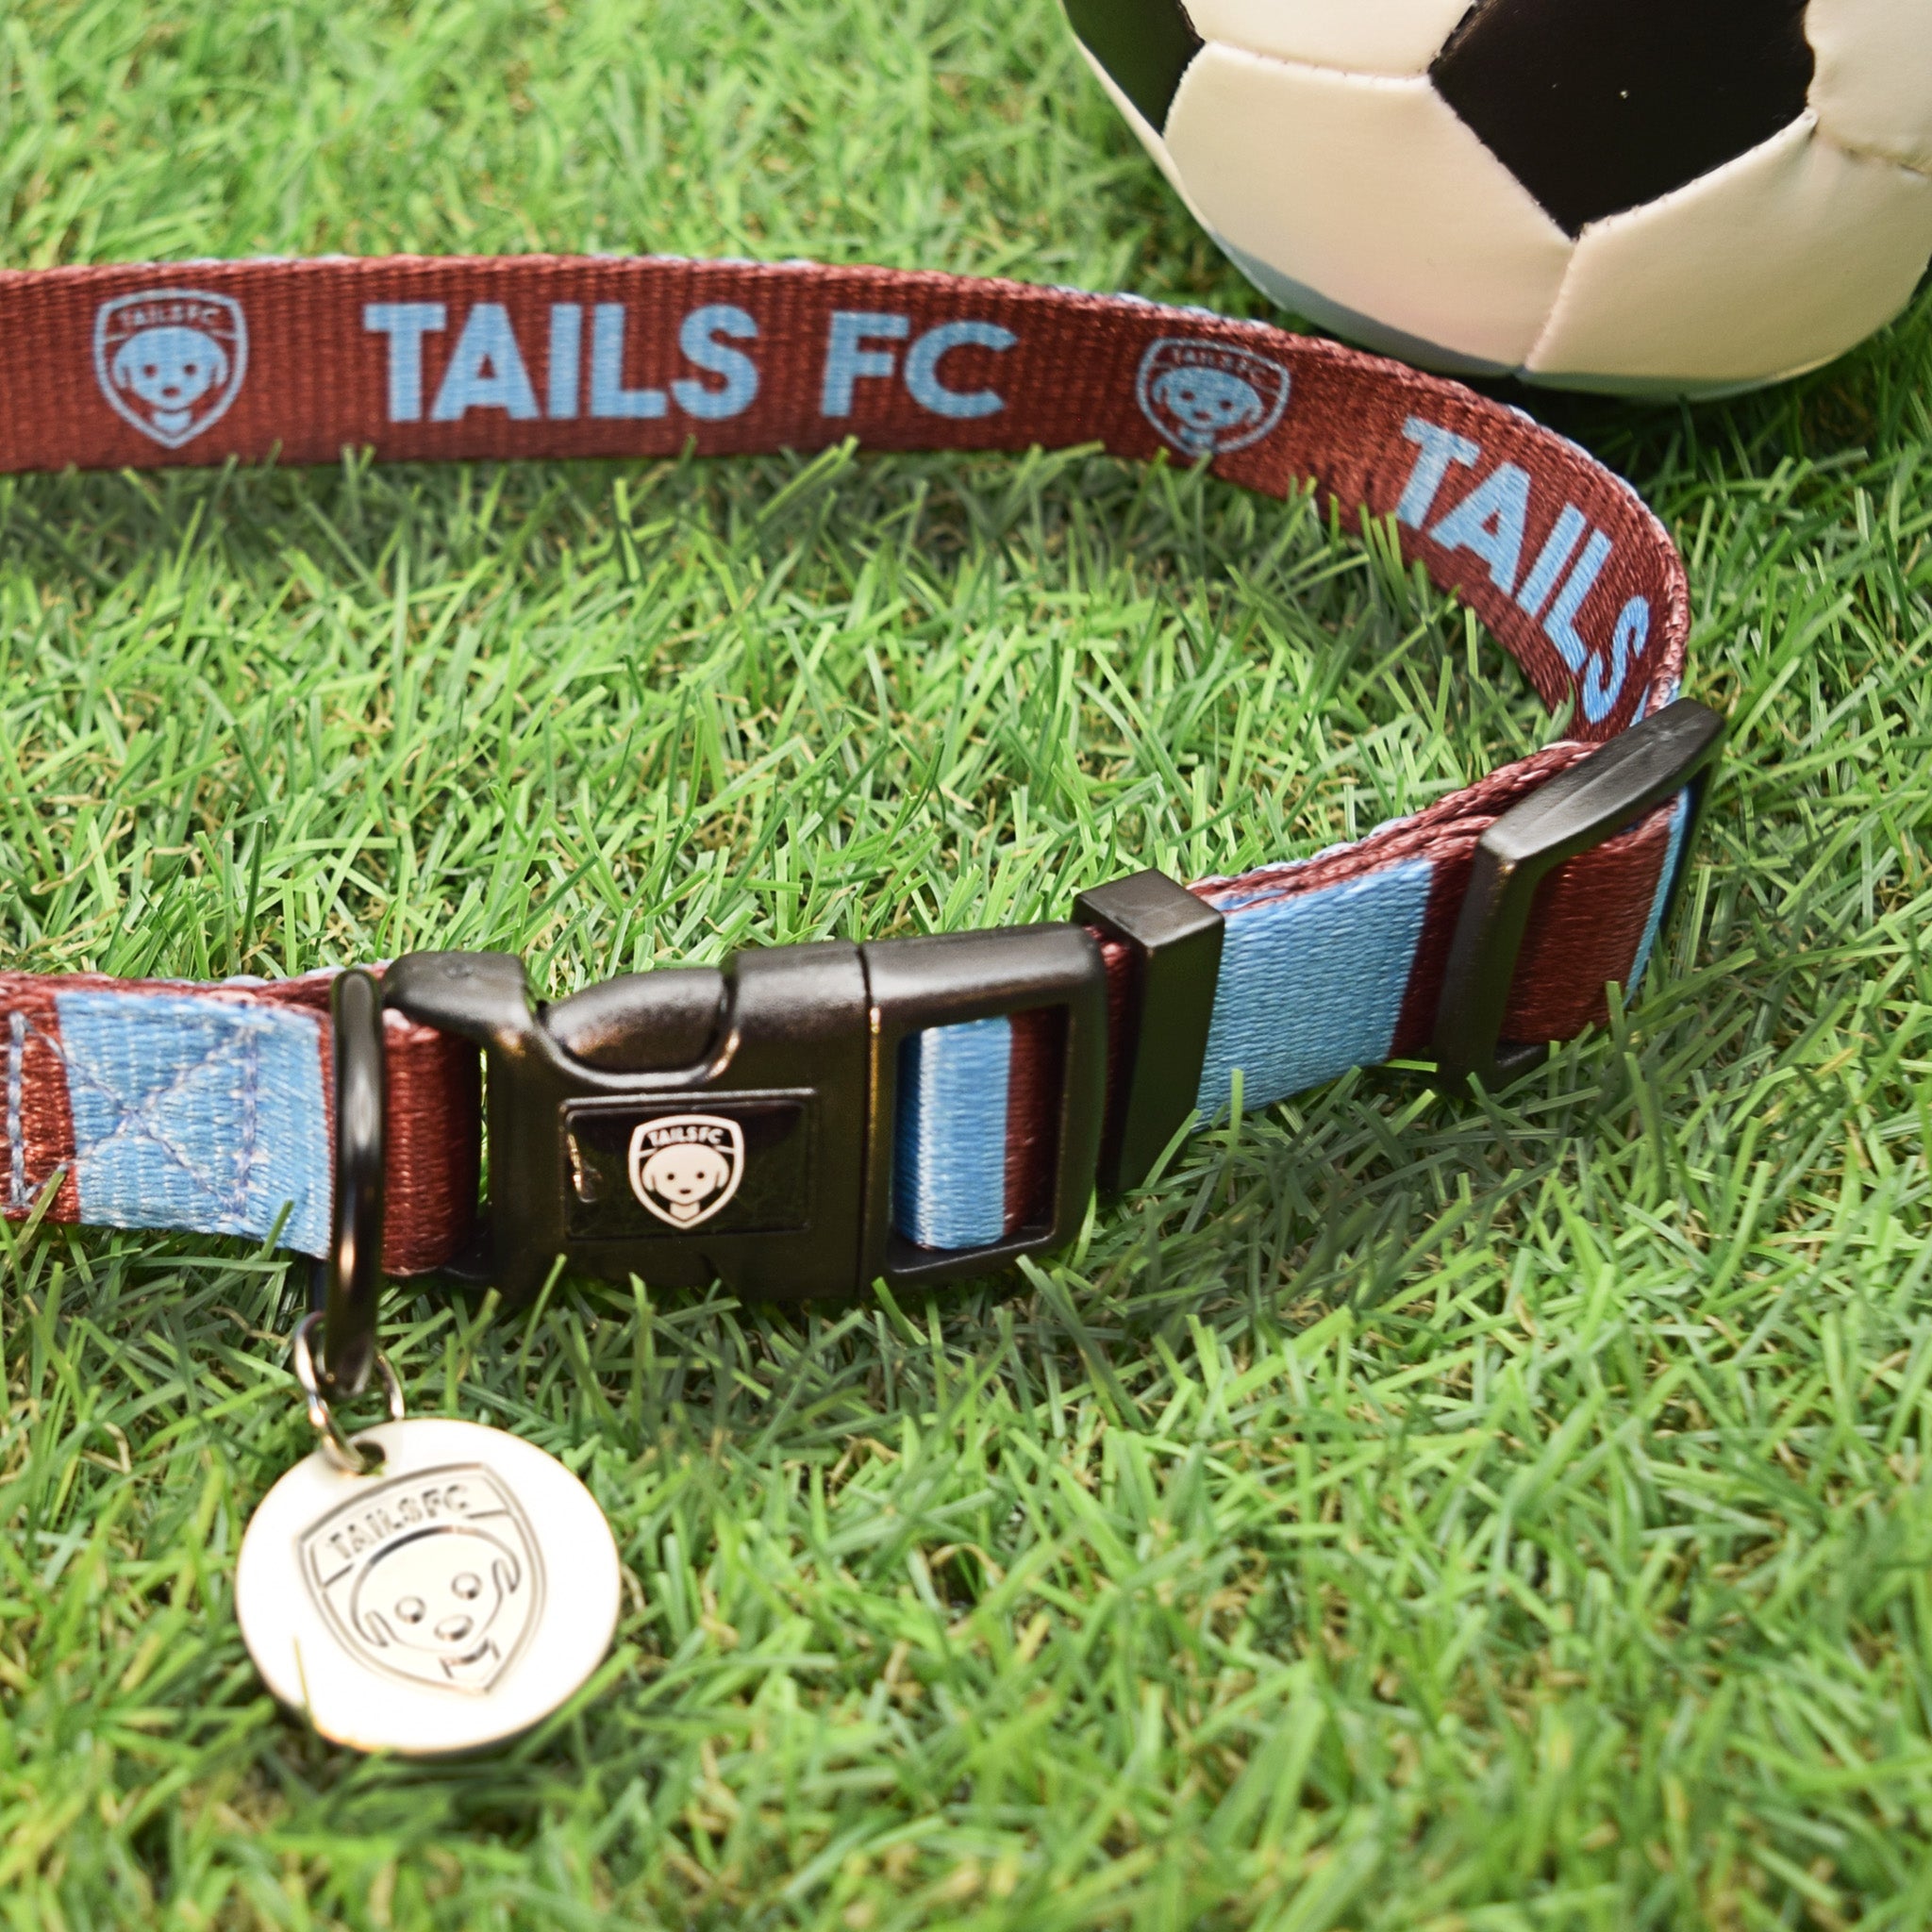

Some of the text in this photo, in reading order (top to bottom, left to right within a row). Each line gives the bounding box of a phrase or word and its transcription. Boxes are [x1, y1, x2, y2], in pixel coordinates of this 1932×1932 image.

[362, 302, 1018, 422] TAILS FC
[1394, 414, 1651, 724] TAILS
